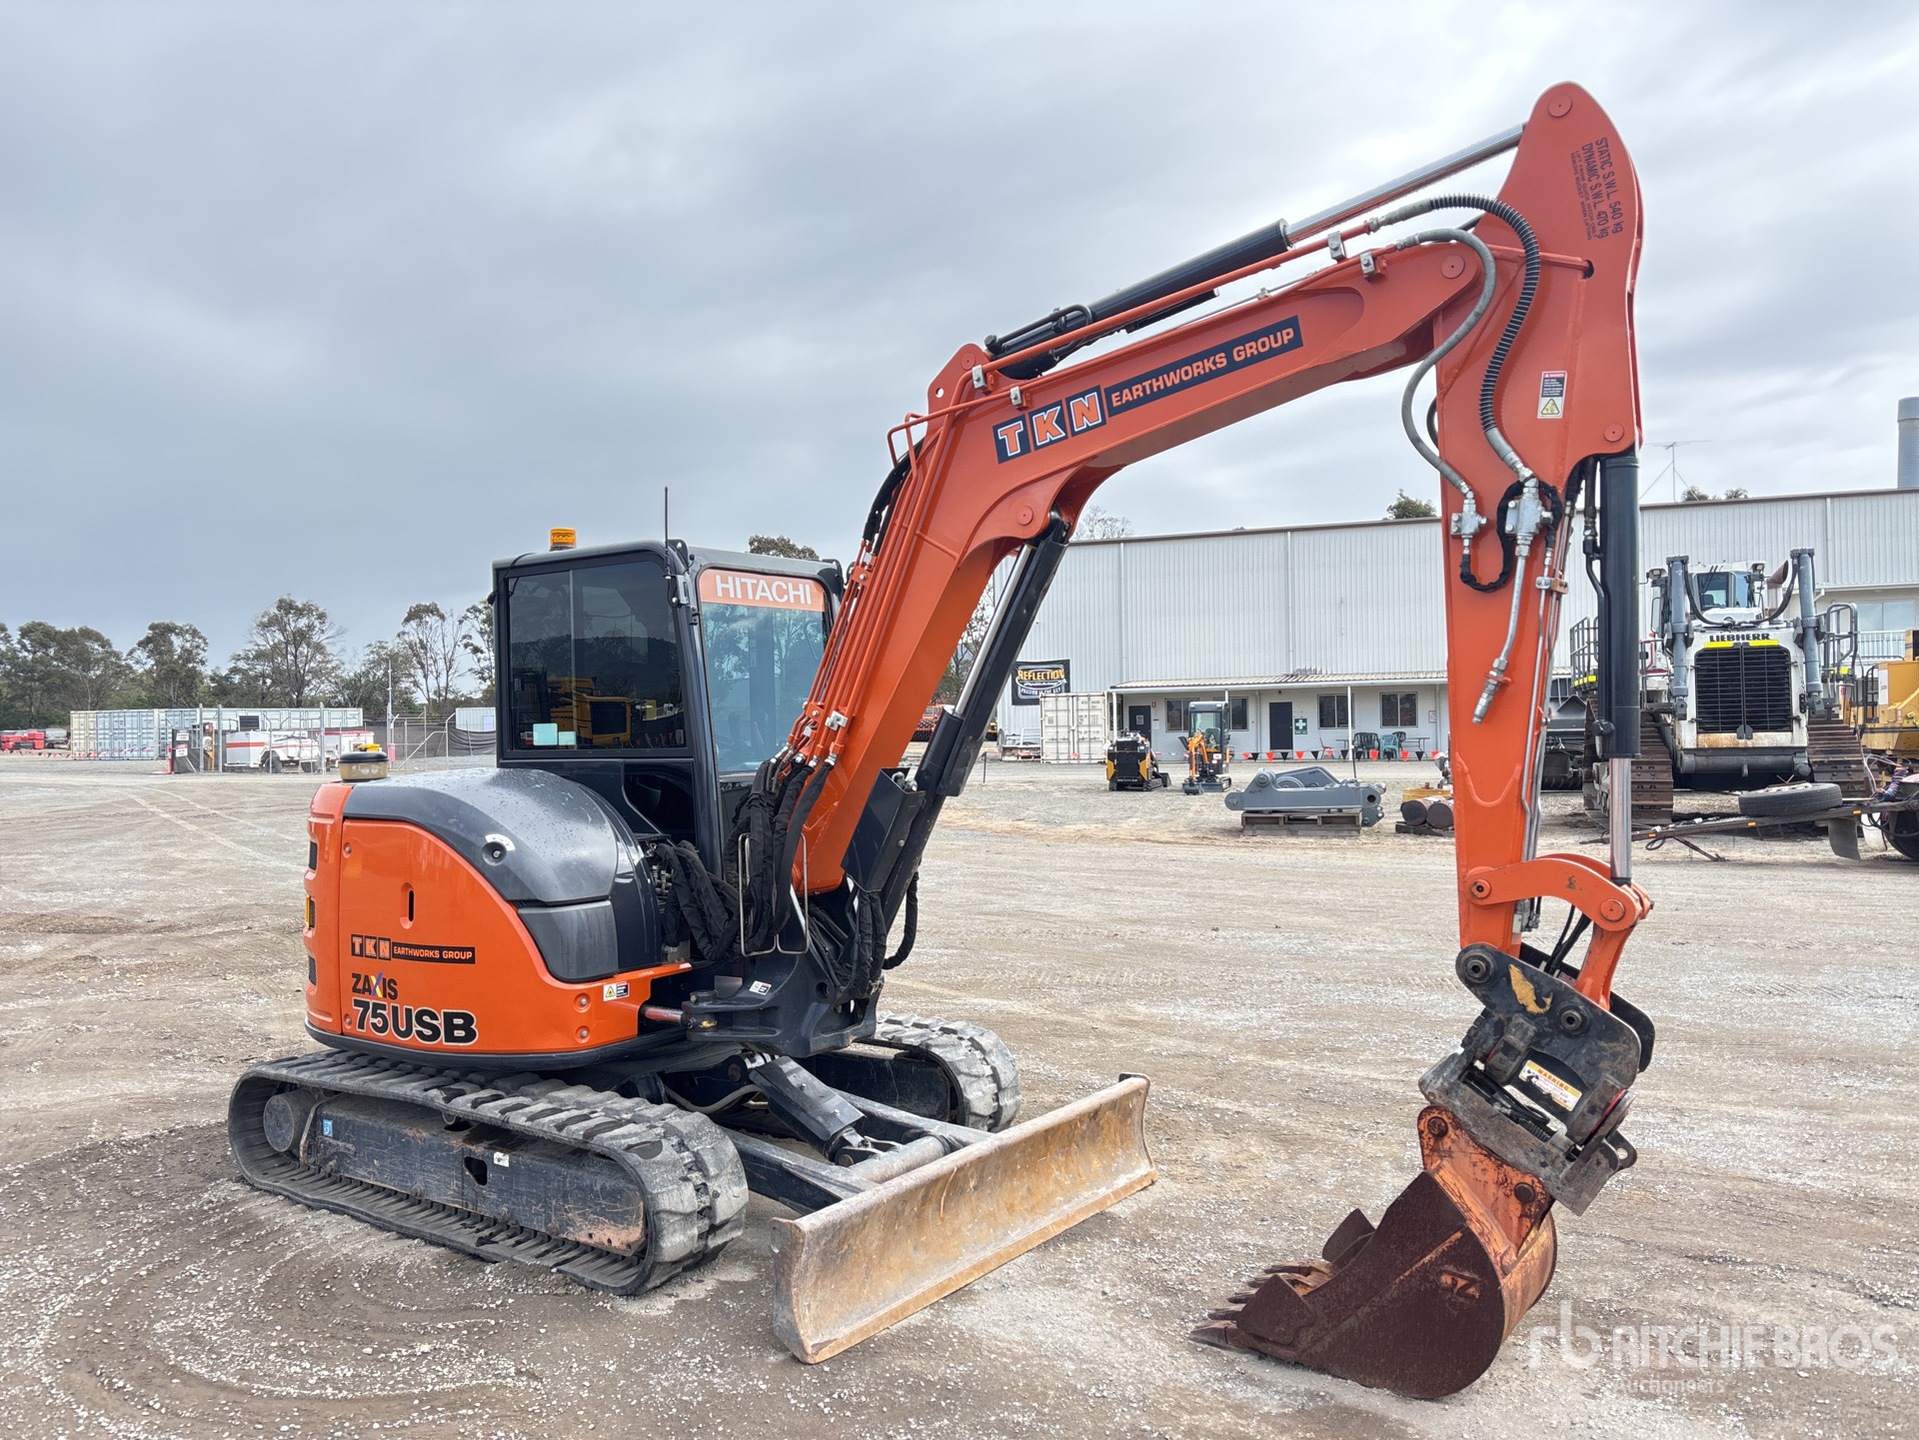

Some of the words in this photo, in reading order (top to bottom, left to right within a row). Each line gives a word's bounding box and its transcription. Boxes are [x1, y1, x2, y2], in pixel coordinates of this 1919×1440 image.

[1581, 143, 1600, 182] DYNAMIC
[1595, 137, 1613, 170] STATIC
[1596, 211, 1609, 226] 470
[1609, 201, 1623, 220] 540
[1597, 226, 1610, 239] kg
[1612, 220, 1625, 234] kg
[998, 391, 1103, 457] TKN
[1111, 352, 1227, 407] EARTHWORKS
[1233, 327, 1295, 362] GROUP
[715, 575, 811, 605] HITACHI
[1709, 633, 1770, 642] LIEBHERR
[1018, 668, 1065, 681] REFLECTION
[352, 936, 390, 959] TKN
[393, 946, 440, 958] EARTHWORKS
[441, 950, 473, 960] GROUP
[352, 972, 398, 1000] ZAXIS
[352, 997, 478, 1045] 75USB
[1537, 1068, 1569, 1091] WARNING
